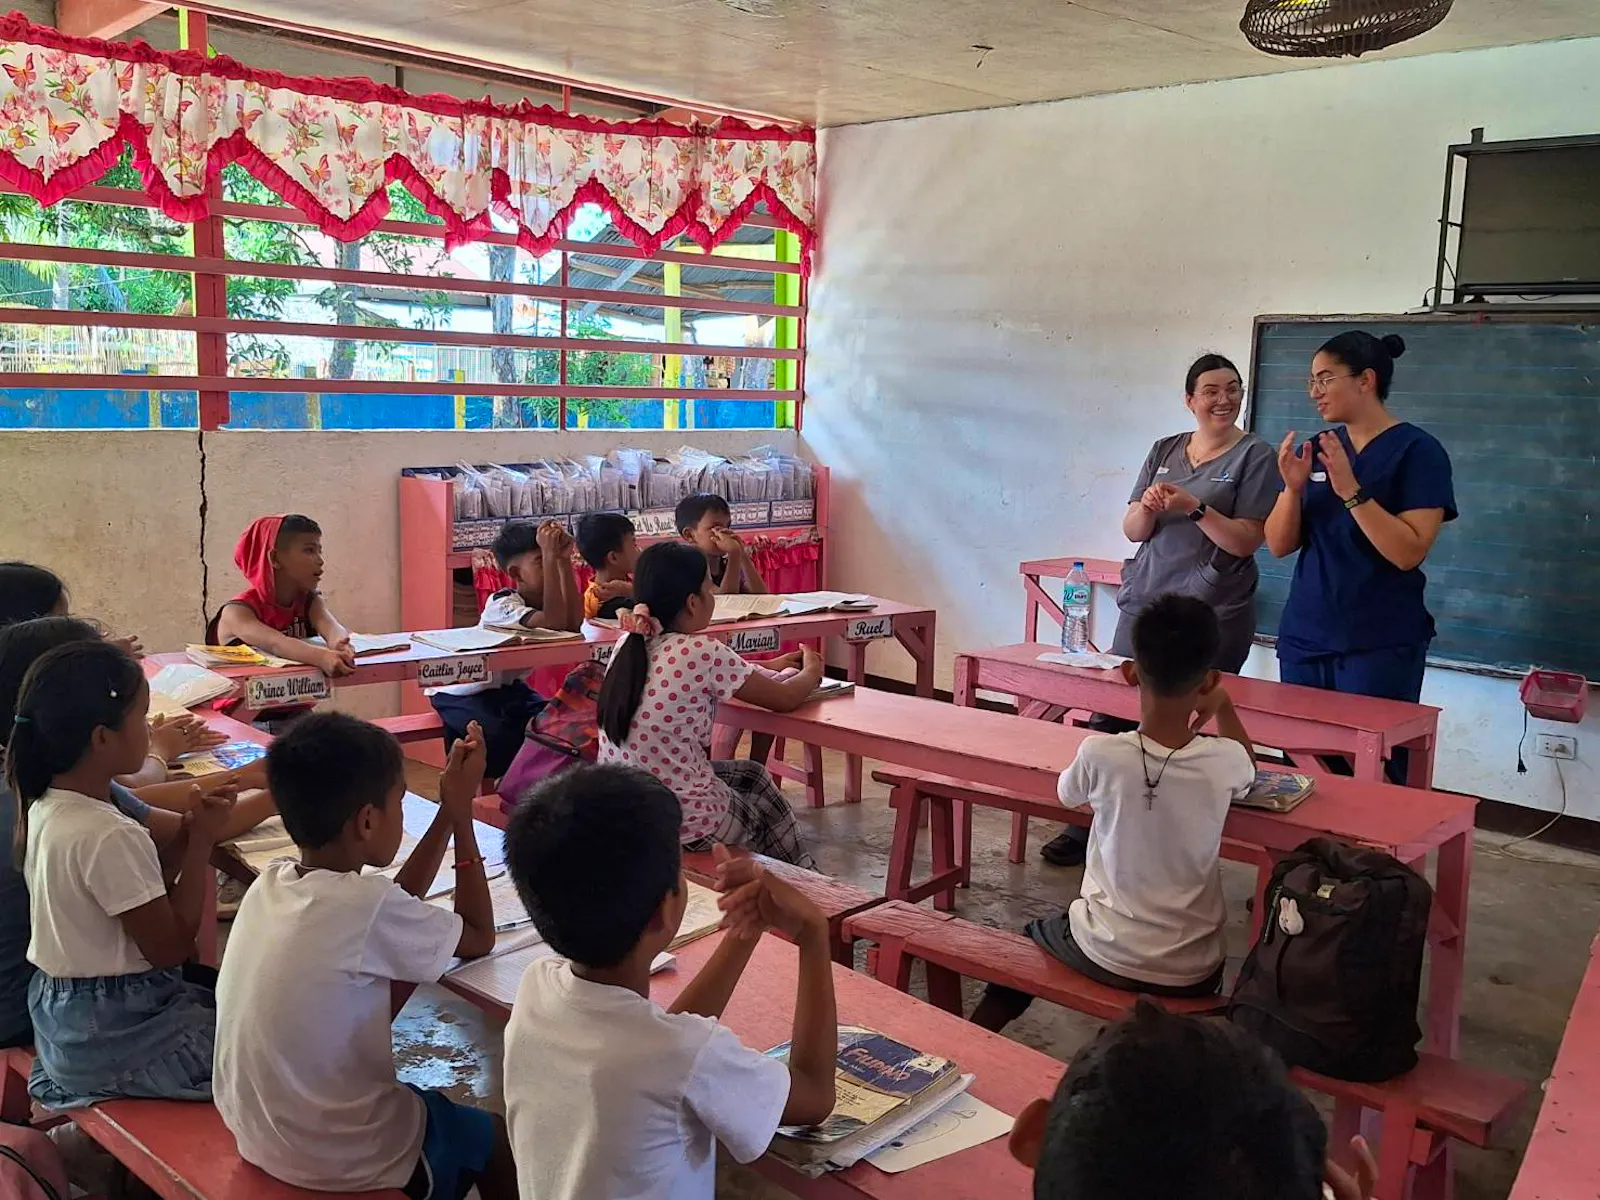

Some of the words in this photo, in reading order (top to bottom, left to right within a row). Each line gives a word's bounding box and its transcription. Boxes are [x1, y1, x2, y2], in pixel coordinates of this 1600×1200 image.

[854, 619, 885, 636] Ruel
[731, 632, 774, 650] Marian
[422, 662, 454, 678] Caitlin
[457, 661, 483, 679] Joyce
[255, 681, 285, 699] Prince
[287, 676, 324, 696] William
